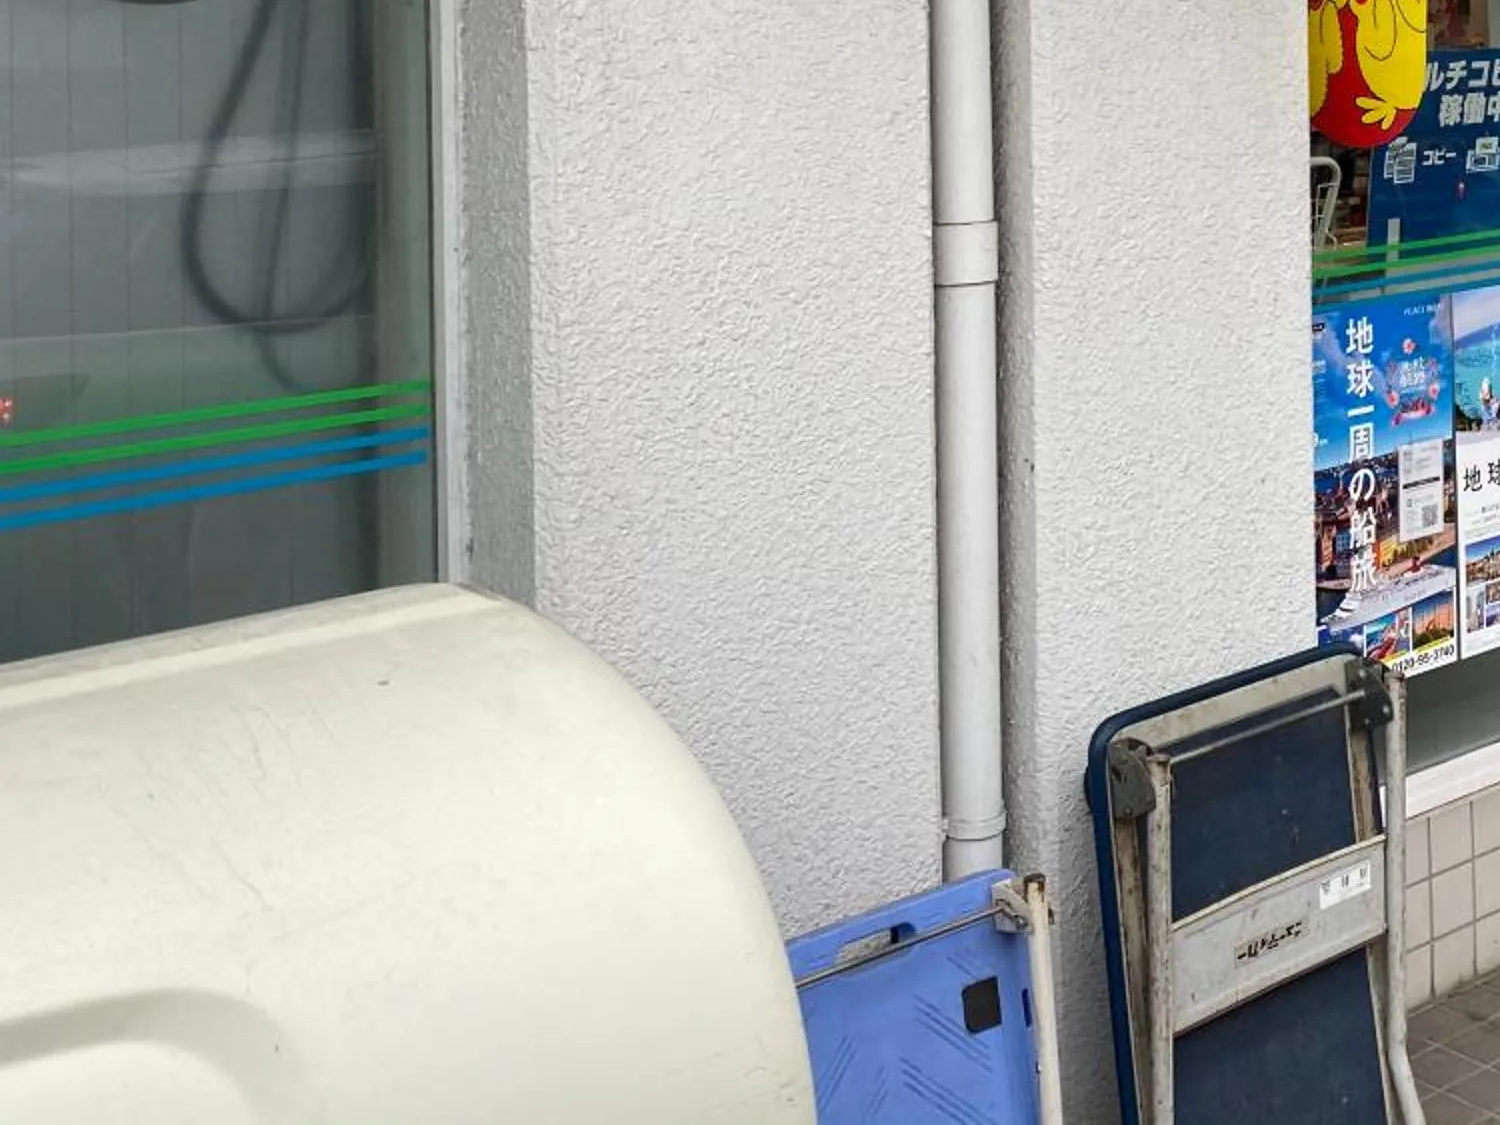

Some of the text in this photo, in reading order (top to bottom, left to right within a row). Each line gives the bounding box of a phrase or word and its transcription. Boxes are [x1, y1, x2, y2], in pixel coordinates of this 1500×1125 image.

[1422, 148, 1457, 166] コピー
[1345, 315, 1381, 595] 地球一周の船旅
